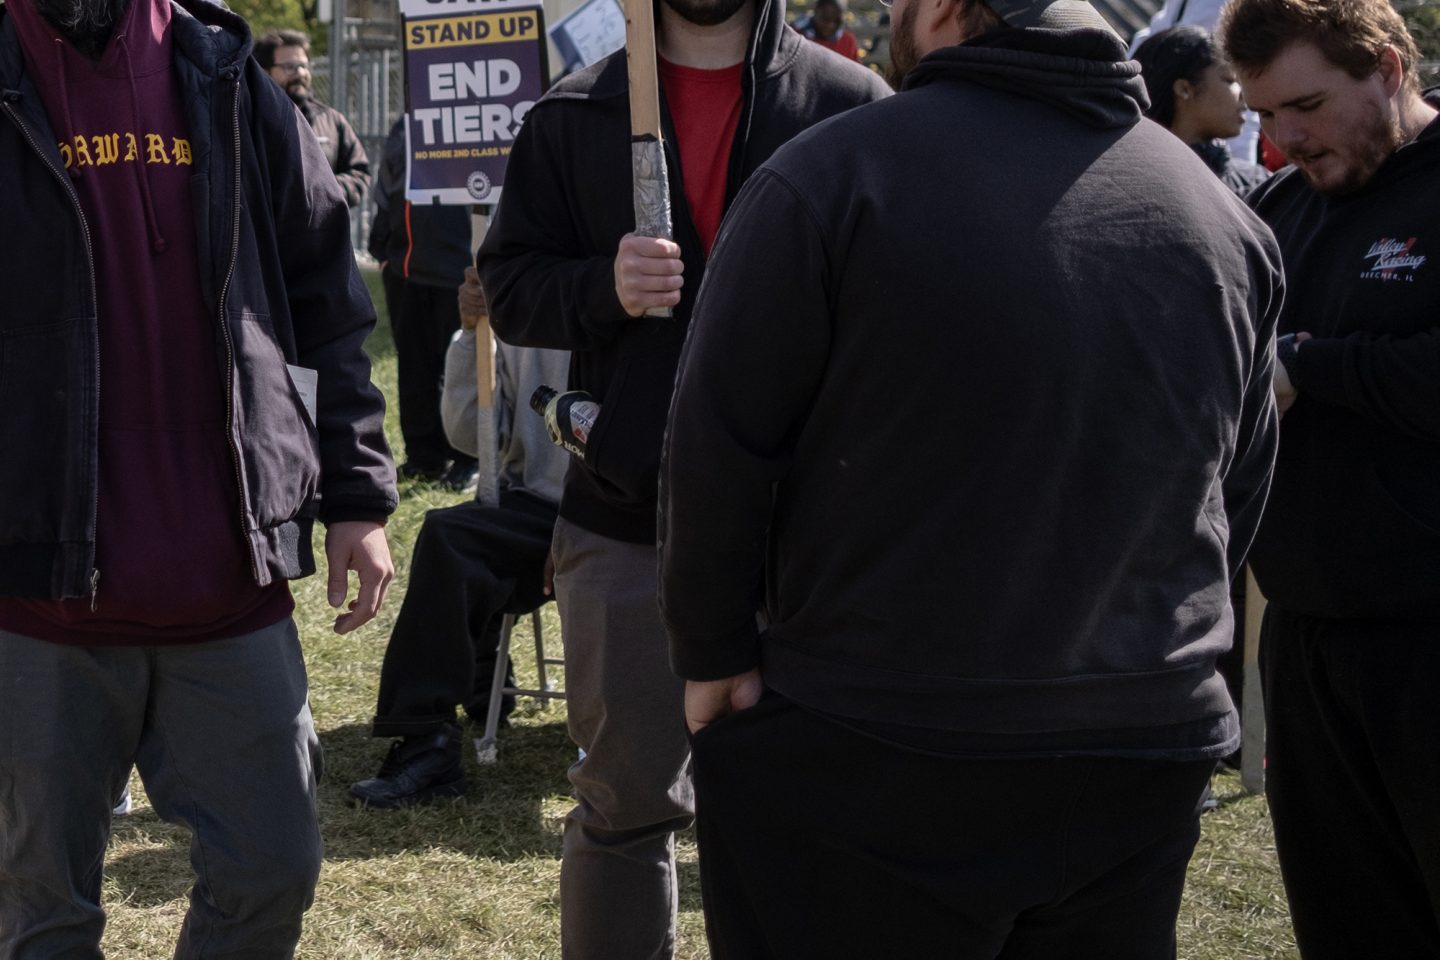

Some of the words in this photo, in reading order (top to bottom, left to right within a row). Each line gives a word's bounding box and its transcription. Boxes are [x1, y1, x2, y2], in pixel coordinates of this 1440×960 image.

[411, 20, 490, 45] STAND
[499, 16, 534, 38] UP
[428, 58, 521, 102] END
[415, 150, 428, 159] NO
[471, 146, 498, 157] CLASS
[1371, 253, 1427, 271] Racing
